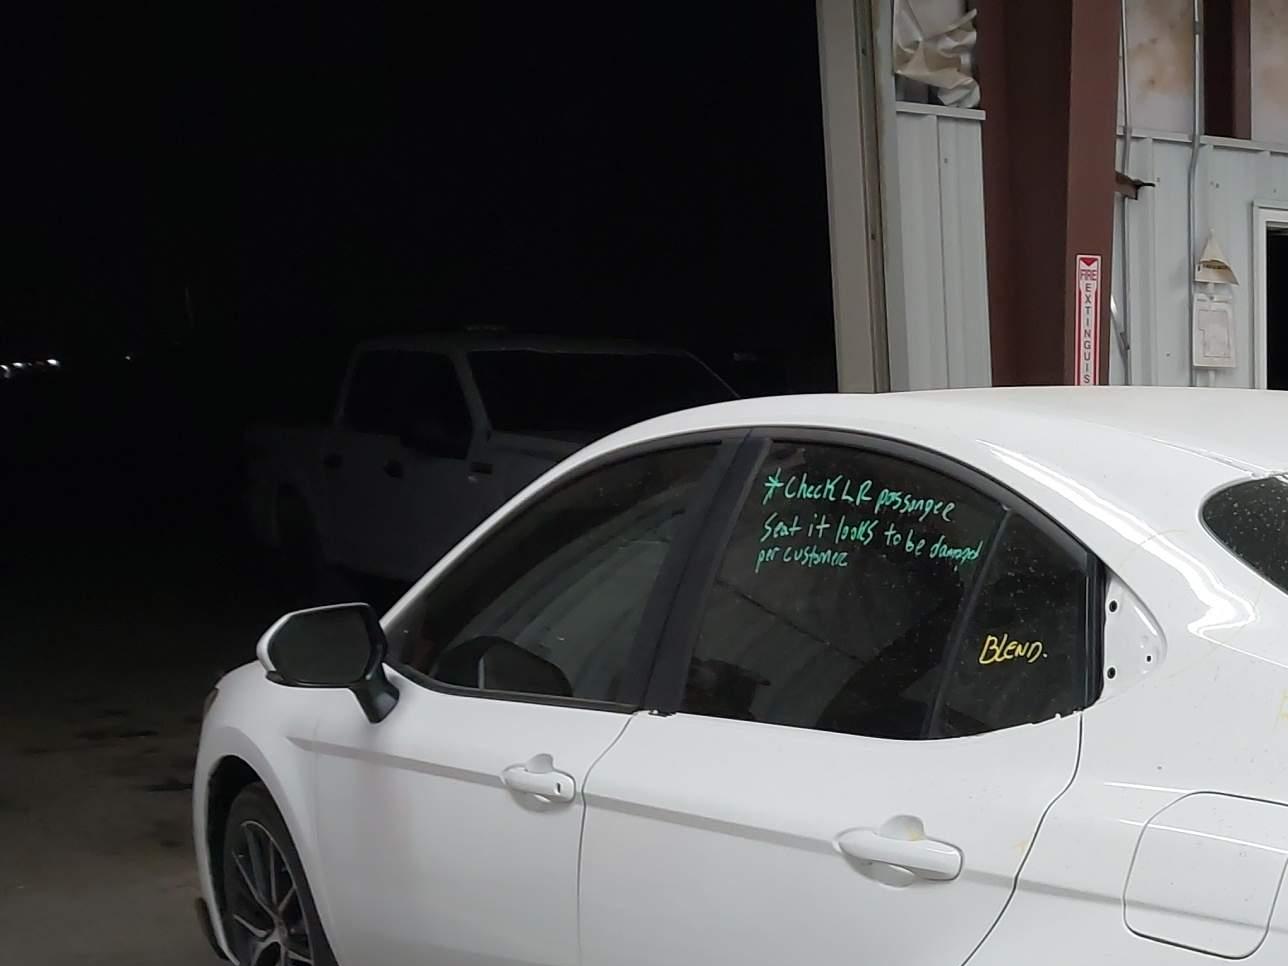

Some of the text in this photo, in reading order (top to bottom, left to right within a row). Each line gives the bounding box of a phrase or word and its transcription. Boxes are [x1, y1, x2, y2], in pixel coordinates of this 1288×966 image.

[1080, 269, 1097, 281] FIRE
[808, 513, 831, 538] it
[884, 523, 902, 546] to
[905, 530, 926, 557] be
